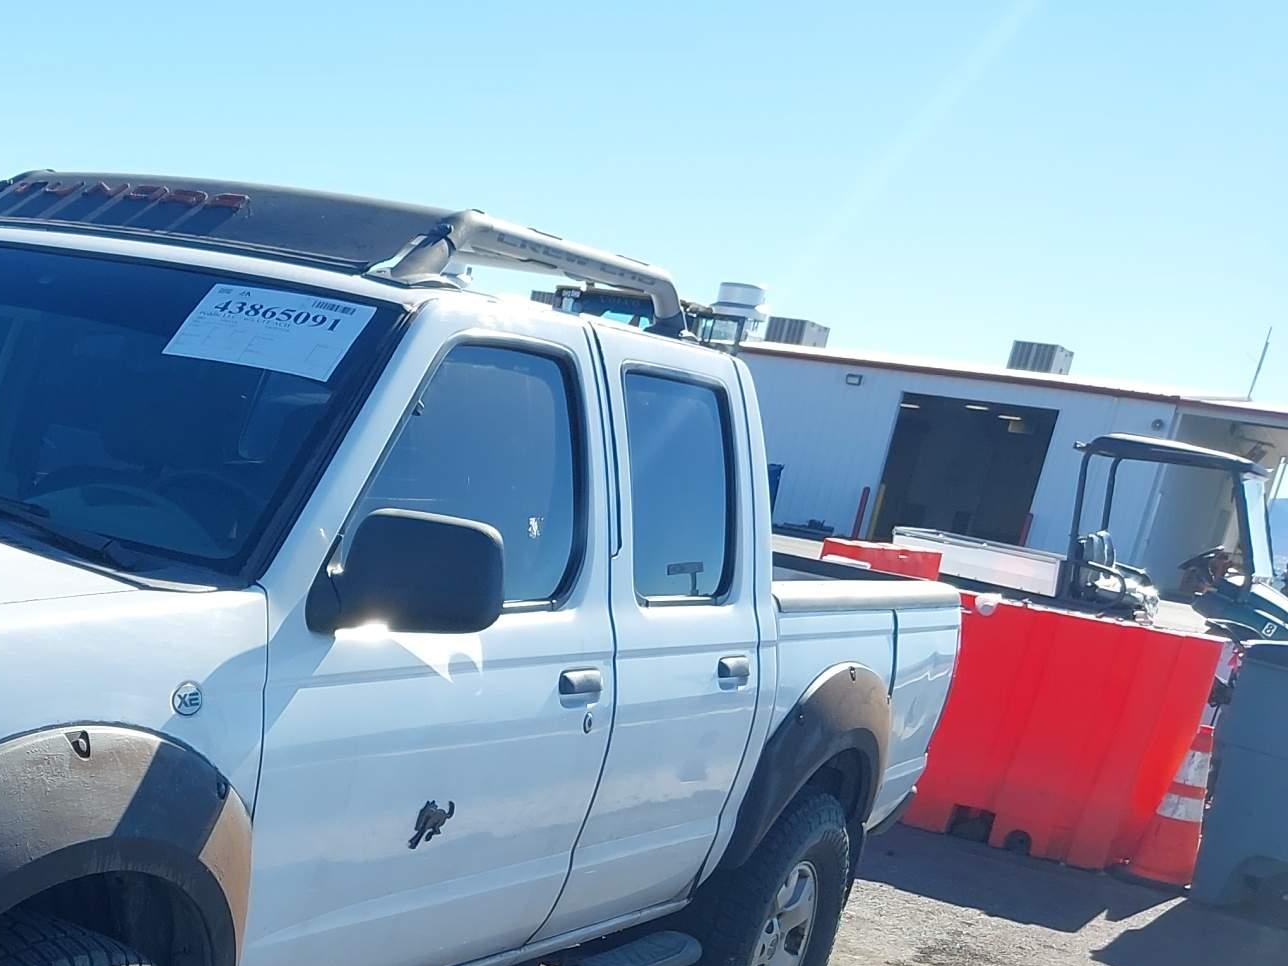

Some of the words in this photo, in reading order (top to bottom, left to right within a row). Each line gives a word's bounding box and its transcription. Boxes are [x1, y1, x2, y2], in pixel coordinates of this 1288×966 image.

[495, 232, 590, 266] CREW
[213, 299, 342, 333] 43865091
[1264, 624, 1275, 635] 8
[176, 691, 201, 709] XE
